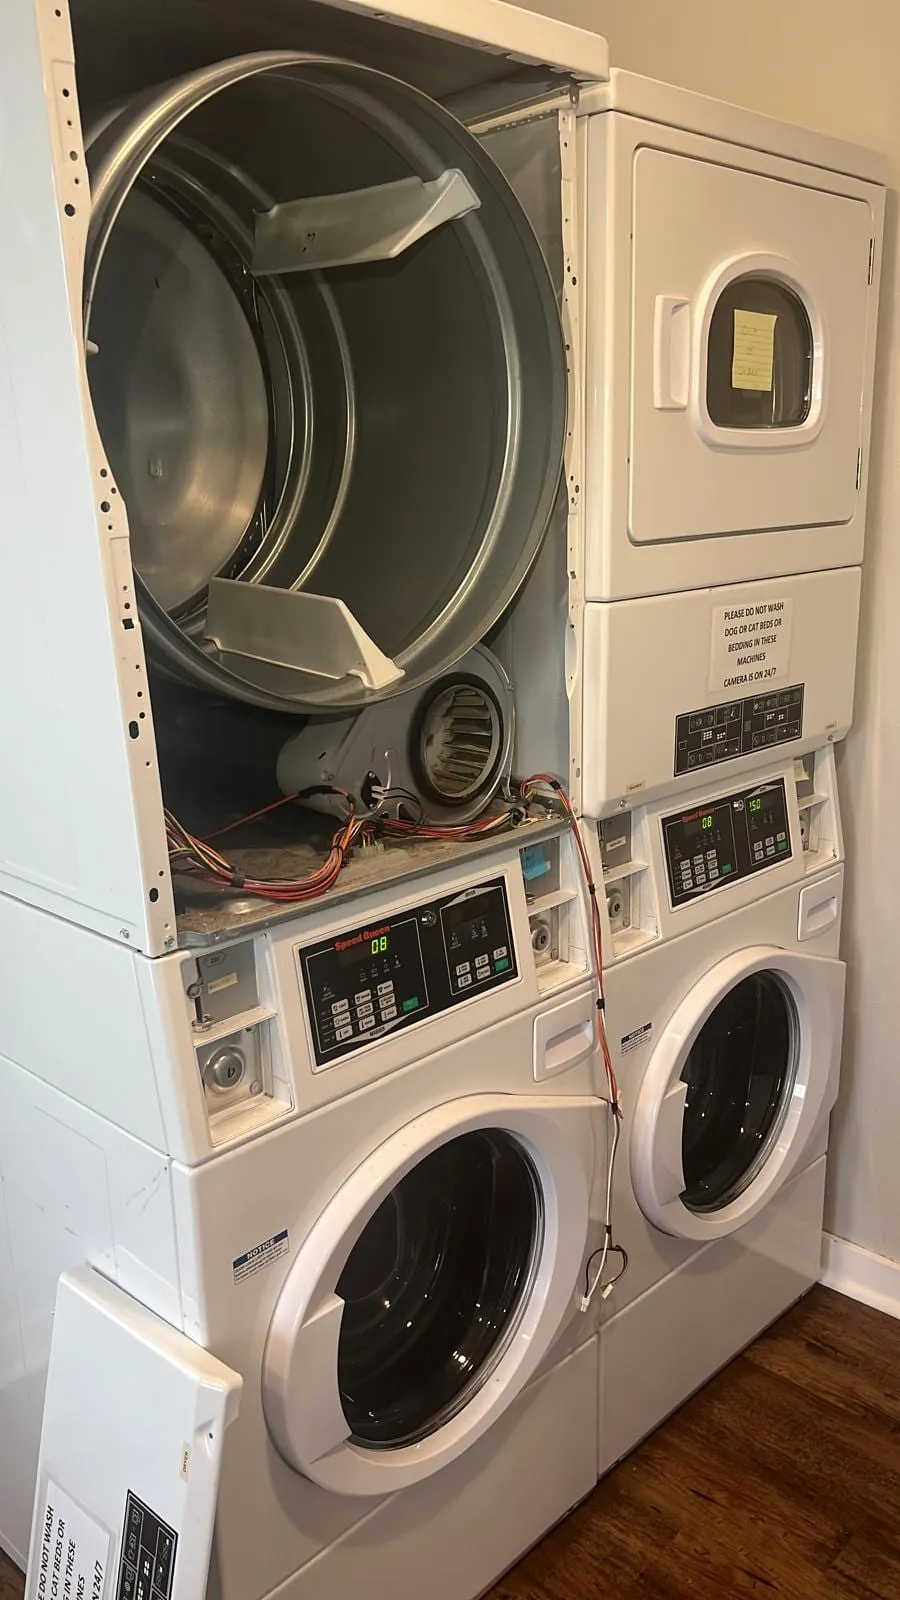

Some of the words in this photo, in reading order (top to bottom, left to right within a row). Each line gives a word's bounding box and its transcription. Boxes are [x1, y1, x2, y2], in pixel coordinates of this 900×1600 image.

[724, 609, 745, 620] PLEASE
[746, 608, 754, 617] DO
[755, 605, 767, 614] NOT
[768, 602, 784, 612] WASH
[725, 627, 738, 637] DOG
[739, 625, 747, 633] OR
[748, 623, 759, 632] CAT
[760, 620, 773, 630] BEDS
[774, 618, 782, 627] OR
[728, 639, 753, 652] BEDDING
[754, 638, 760, 647] IN
[761, 635, 777, 645] THESE
[737, 652, 766, 666] MACHINES
[724, 674, 747, 687] CAMERA
[748, 672, 753, 681] IS
[754, 671, 763, 680] ON
[764, 667, 776, 678] 24/7
[702, 815, 712, 829] 08
[335, 935, 363, 951] Speed
[363, 926, 391, 940] Queen
[371, 936, 387, 954] 08
[247, 1239, 275, 1259] NOTICE
[44, 1505, 54, 1543] WASH
[57, 1519, 66, 1539] OR
[41, 1544, 50, 1572] NOT
[54, 1539, 63, 1572] BEDS
[65, 1539, 77, 1577] THESE
[39, 1573, 47, 1594] DO
[51, 1571, 60, 1597] CAT
[64, 1578, 72, 1594] IN
[93, 1560, 104, 1592] 24/7
